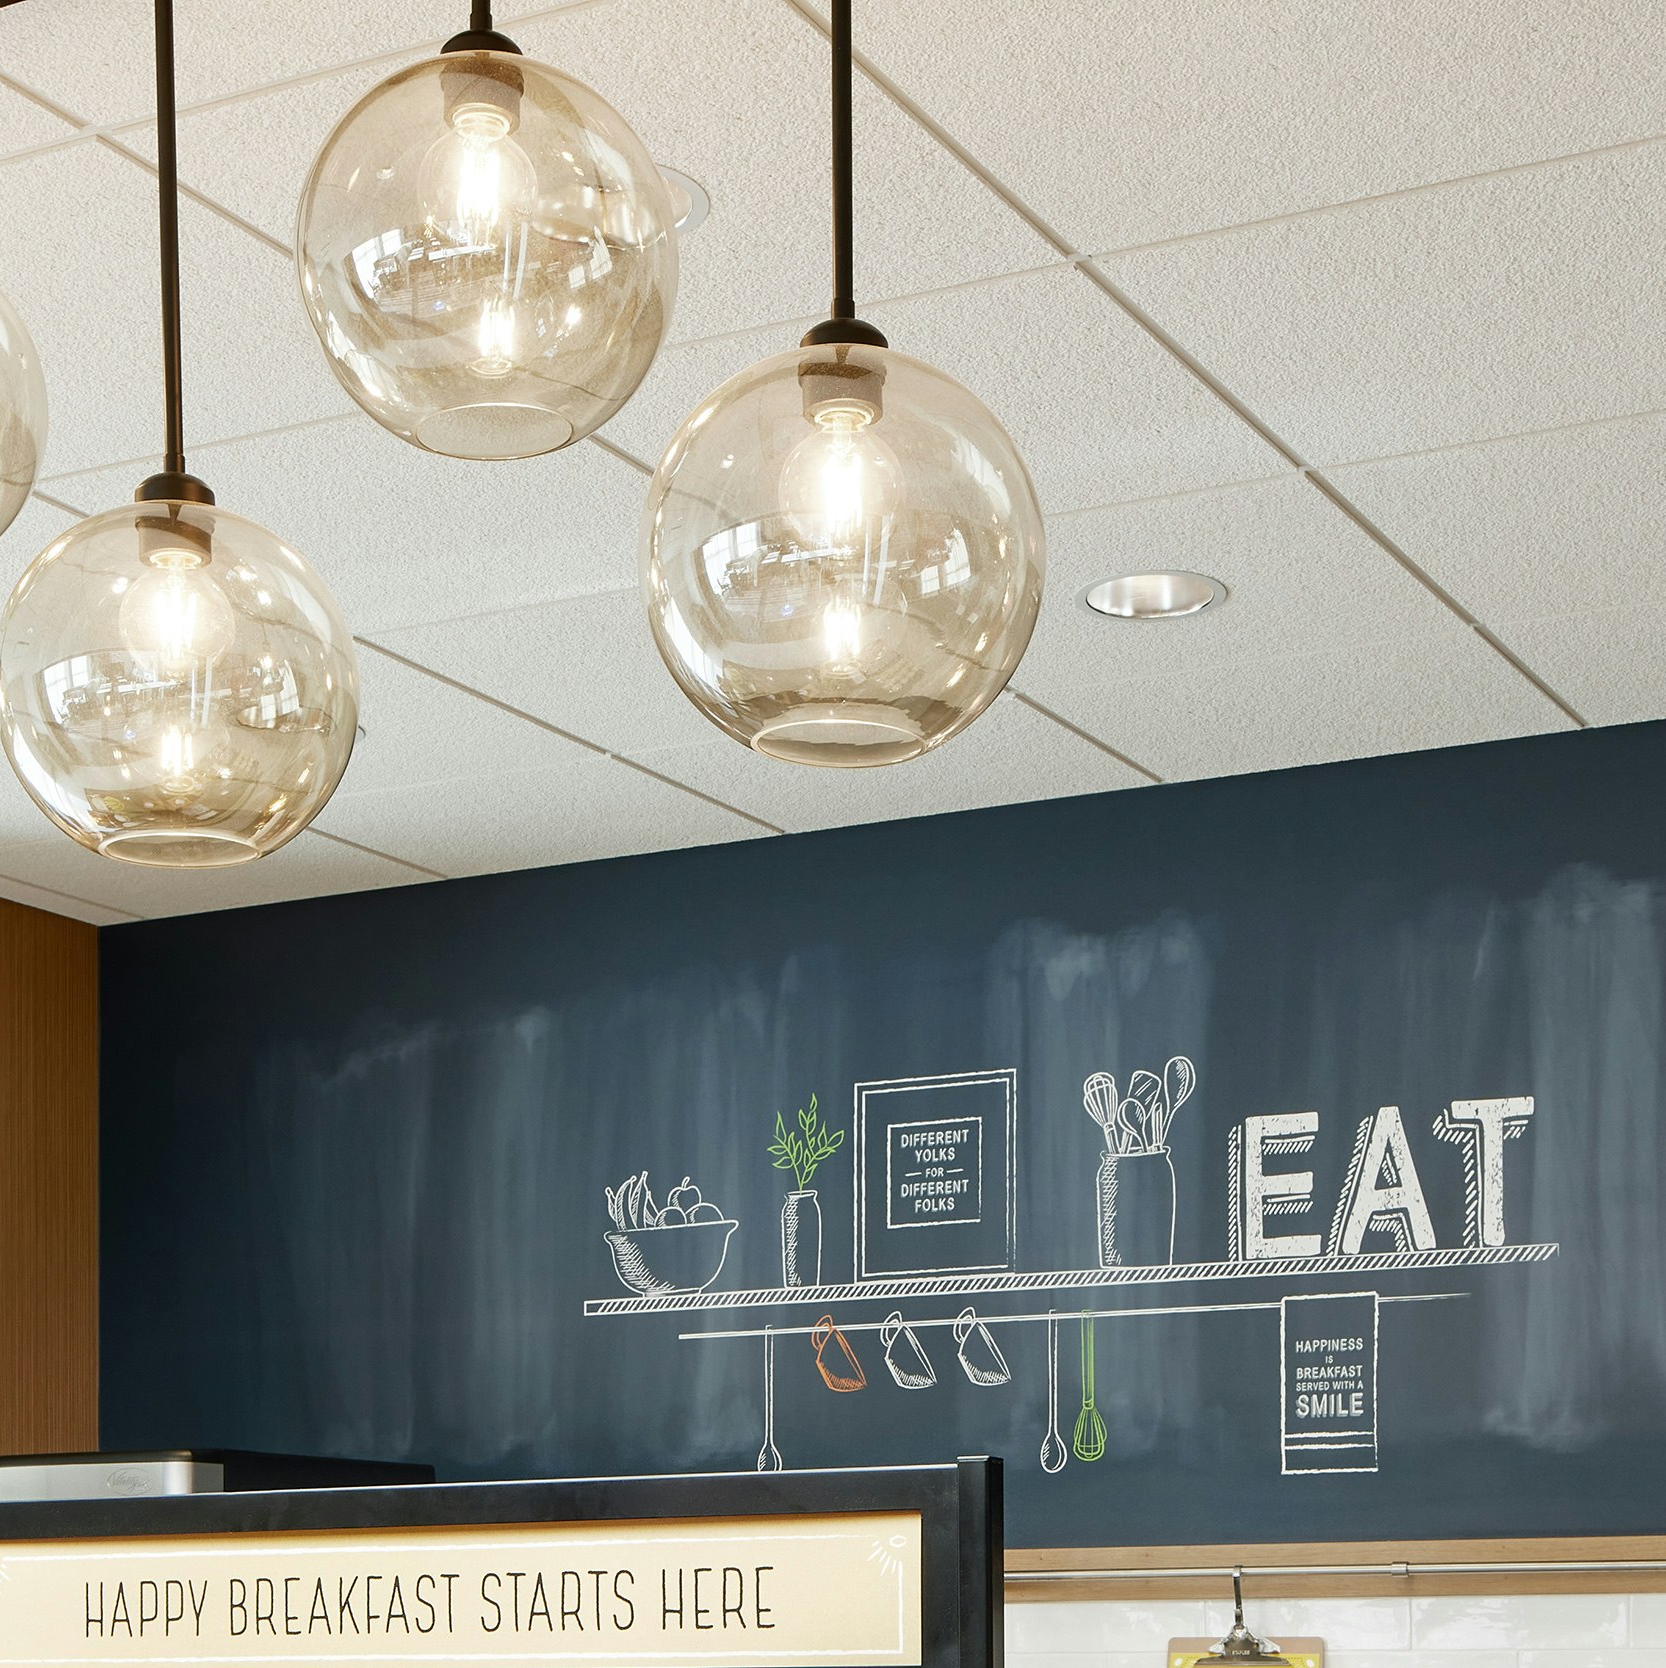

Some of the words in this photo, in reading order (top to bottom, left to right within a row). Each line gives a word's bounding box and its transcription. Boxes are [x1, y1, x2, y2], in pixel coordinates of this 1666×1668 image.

[901, 1129, 969, 1148] DIFFERENT
[915, 1147, 955, 1164] YOLKS
[925, 1167, 944, 1178] FOR
[1238, 1096, 1534, 1260] EAT
[901, 1179, 969, 1198] DIFFERENT
[915, 1197, 955, 1213] FOLKS
[1295, 1338, 1363, 1353] HAPPINESS
[1325, 1355, 1333, 1364] IS
[1296, 1365, 1363, 1379] BREAKFAST
[1296, 1381, 1330, 1391] SERVED
[1333, 1380, 1355, 1390] WITH
[1357, 1380, 1364, 1389] A
[1295, 1392, 1364, 1418] SMILE
[85, 1579, 208, 1638] HAPPY
[229, 1574, 460, 1636] BREAKFAST
[481, 1570, 635, 1632] STARTS
[661, 1566, 776, 1631] HERE
